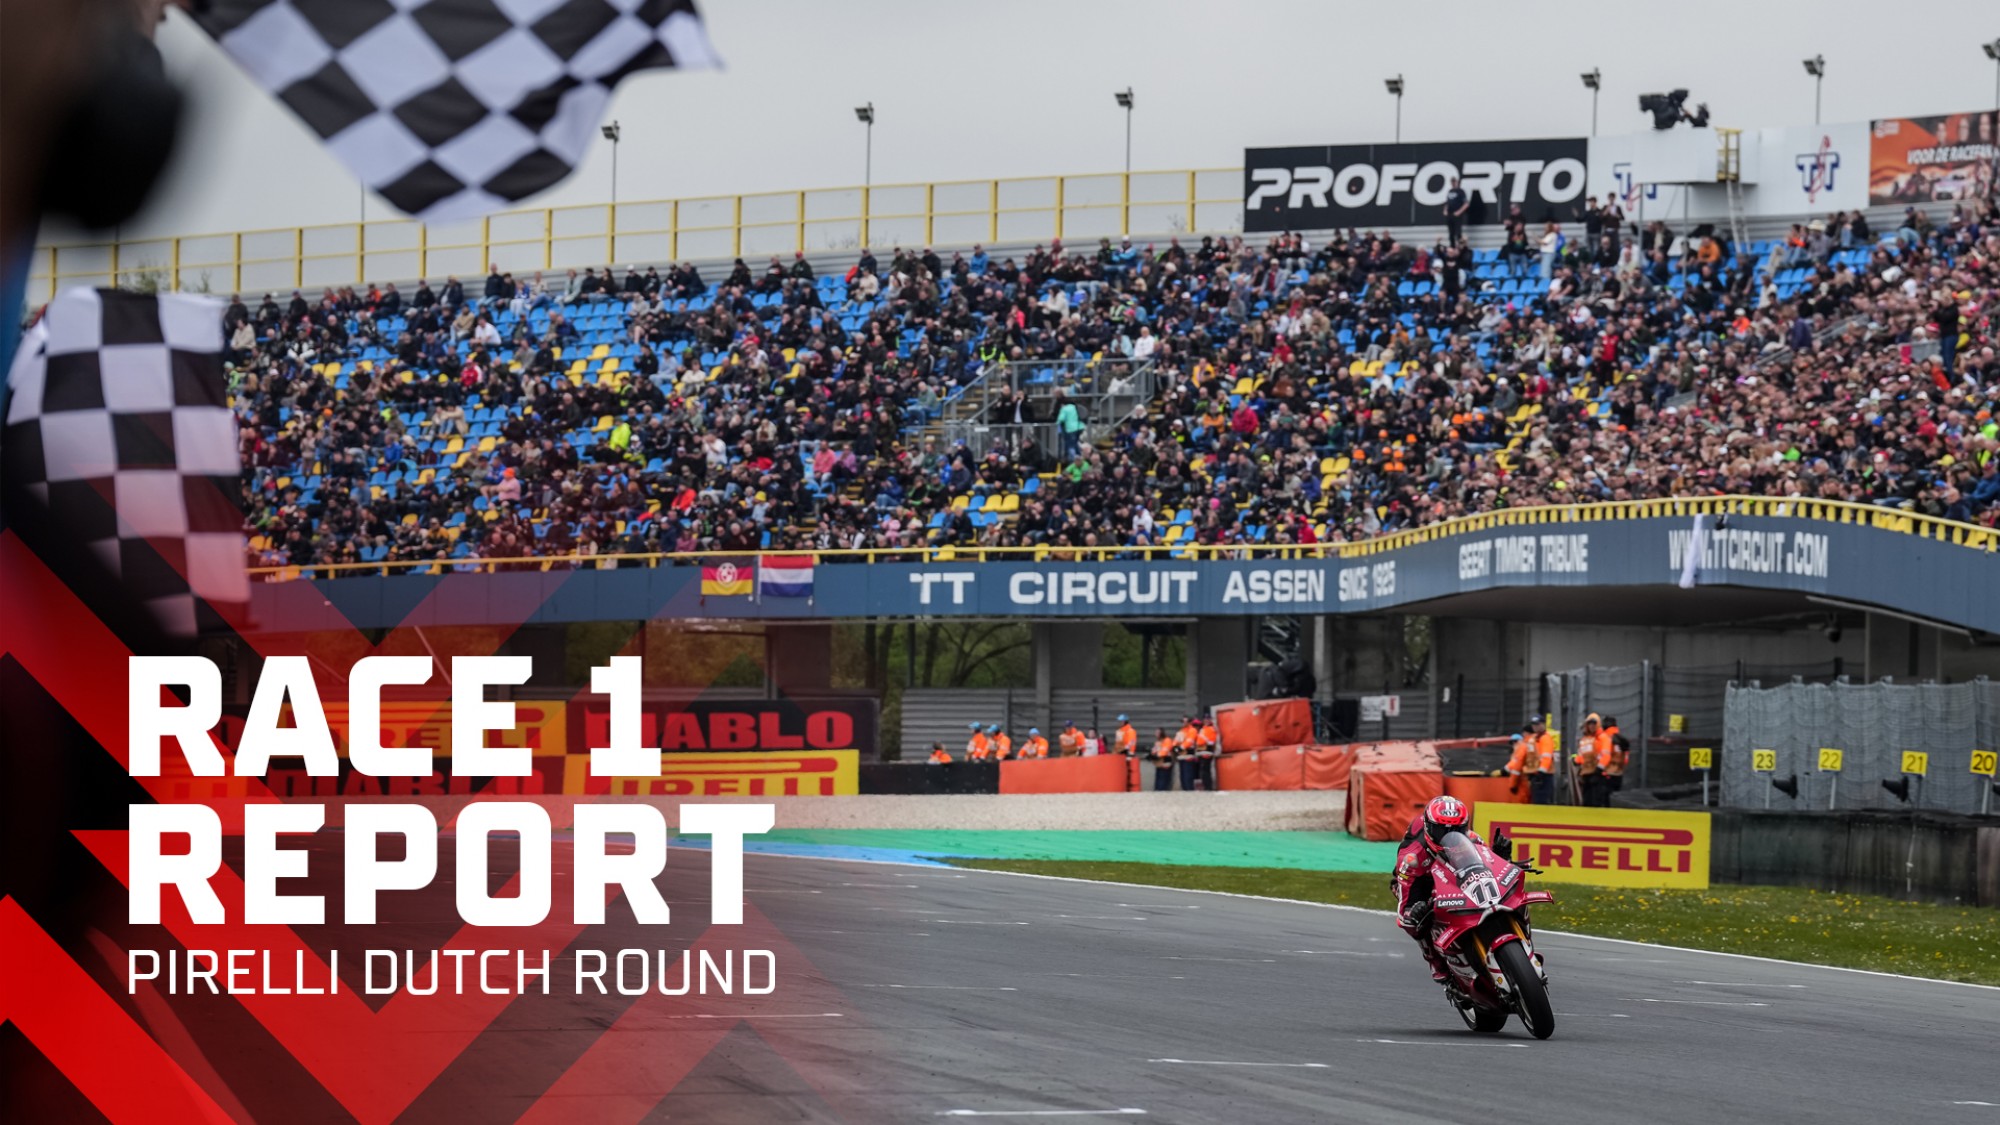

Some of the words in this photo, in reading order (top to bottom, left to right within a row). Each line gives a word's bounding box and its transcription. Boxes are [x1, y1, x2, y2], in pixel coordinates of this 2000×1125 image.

[1247, 158, 1586, 210] PROFORTO
[1540, 534, 1588, 573] TRIBUNE
[910, 572, 974, 604] TT
[1009, 570, 1197, 604] CIRCUIT
[1222, 569, 1325, 603] ASSEN
[1338, 566, 1368, 602] SINCE
[1692, 751, 1709, 766] 24
[1756, 753, 1774, 769] 23
[1822, 752, 1839, 768] 22
[1905, 754, 1924, 771] 21
[1972, 753, 1994, 771] 20
[1489, 821, 1693, 873] PIRELLI
[1500, 868, 1519, 886] Lenovo
[1472, 880, 1498, 906] 11
[1437, 899, 1465, 907] Lenovo
